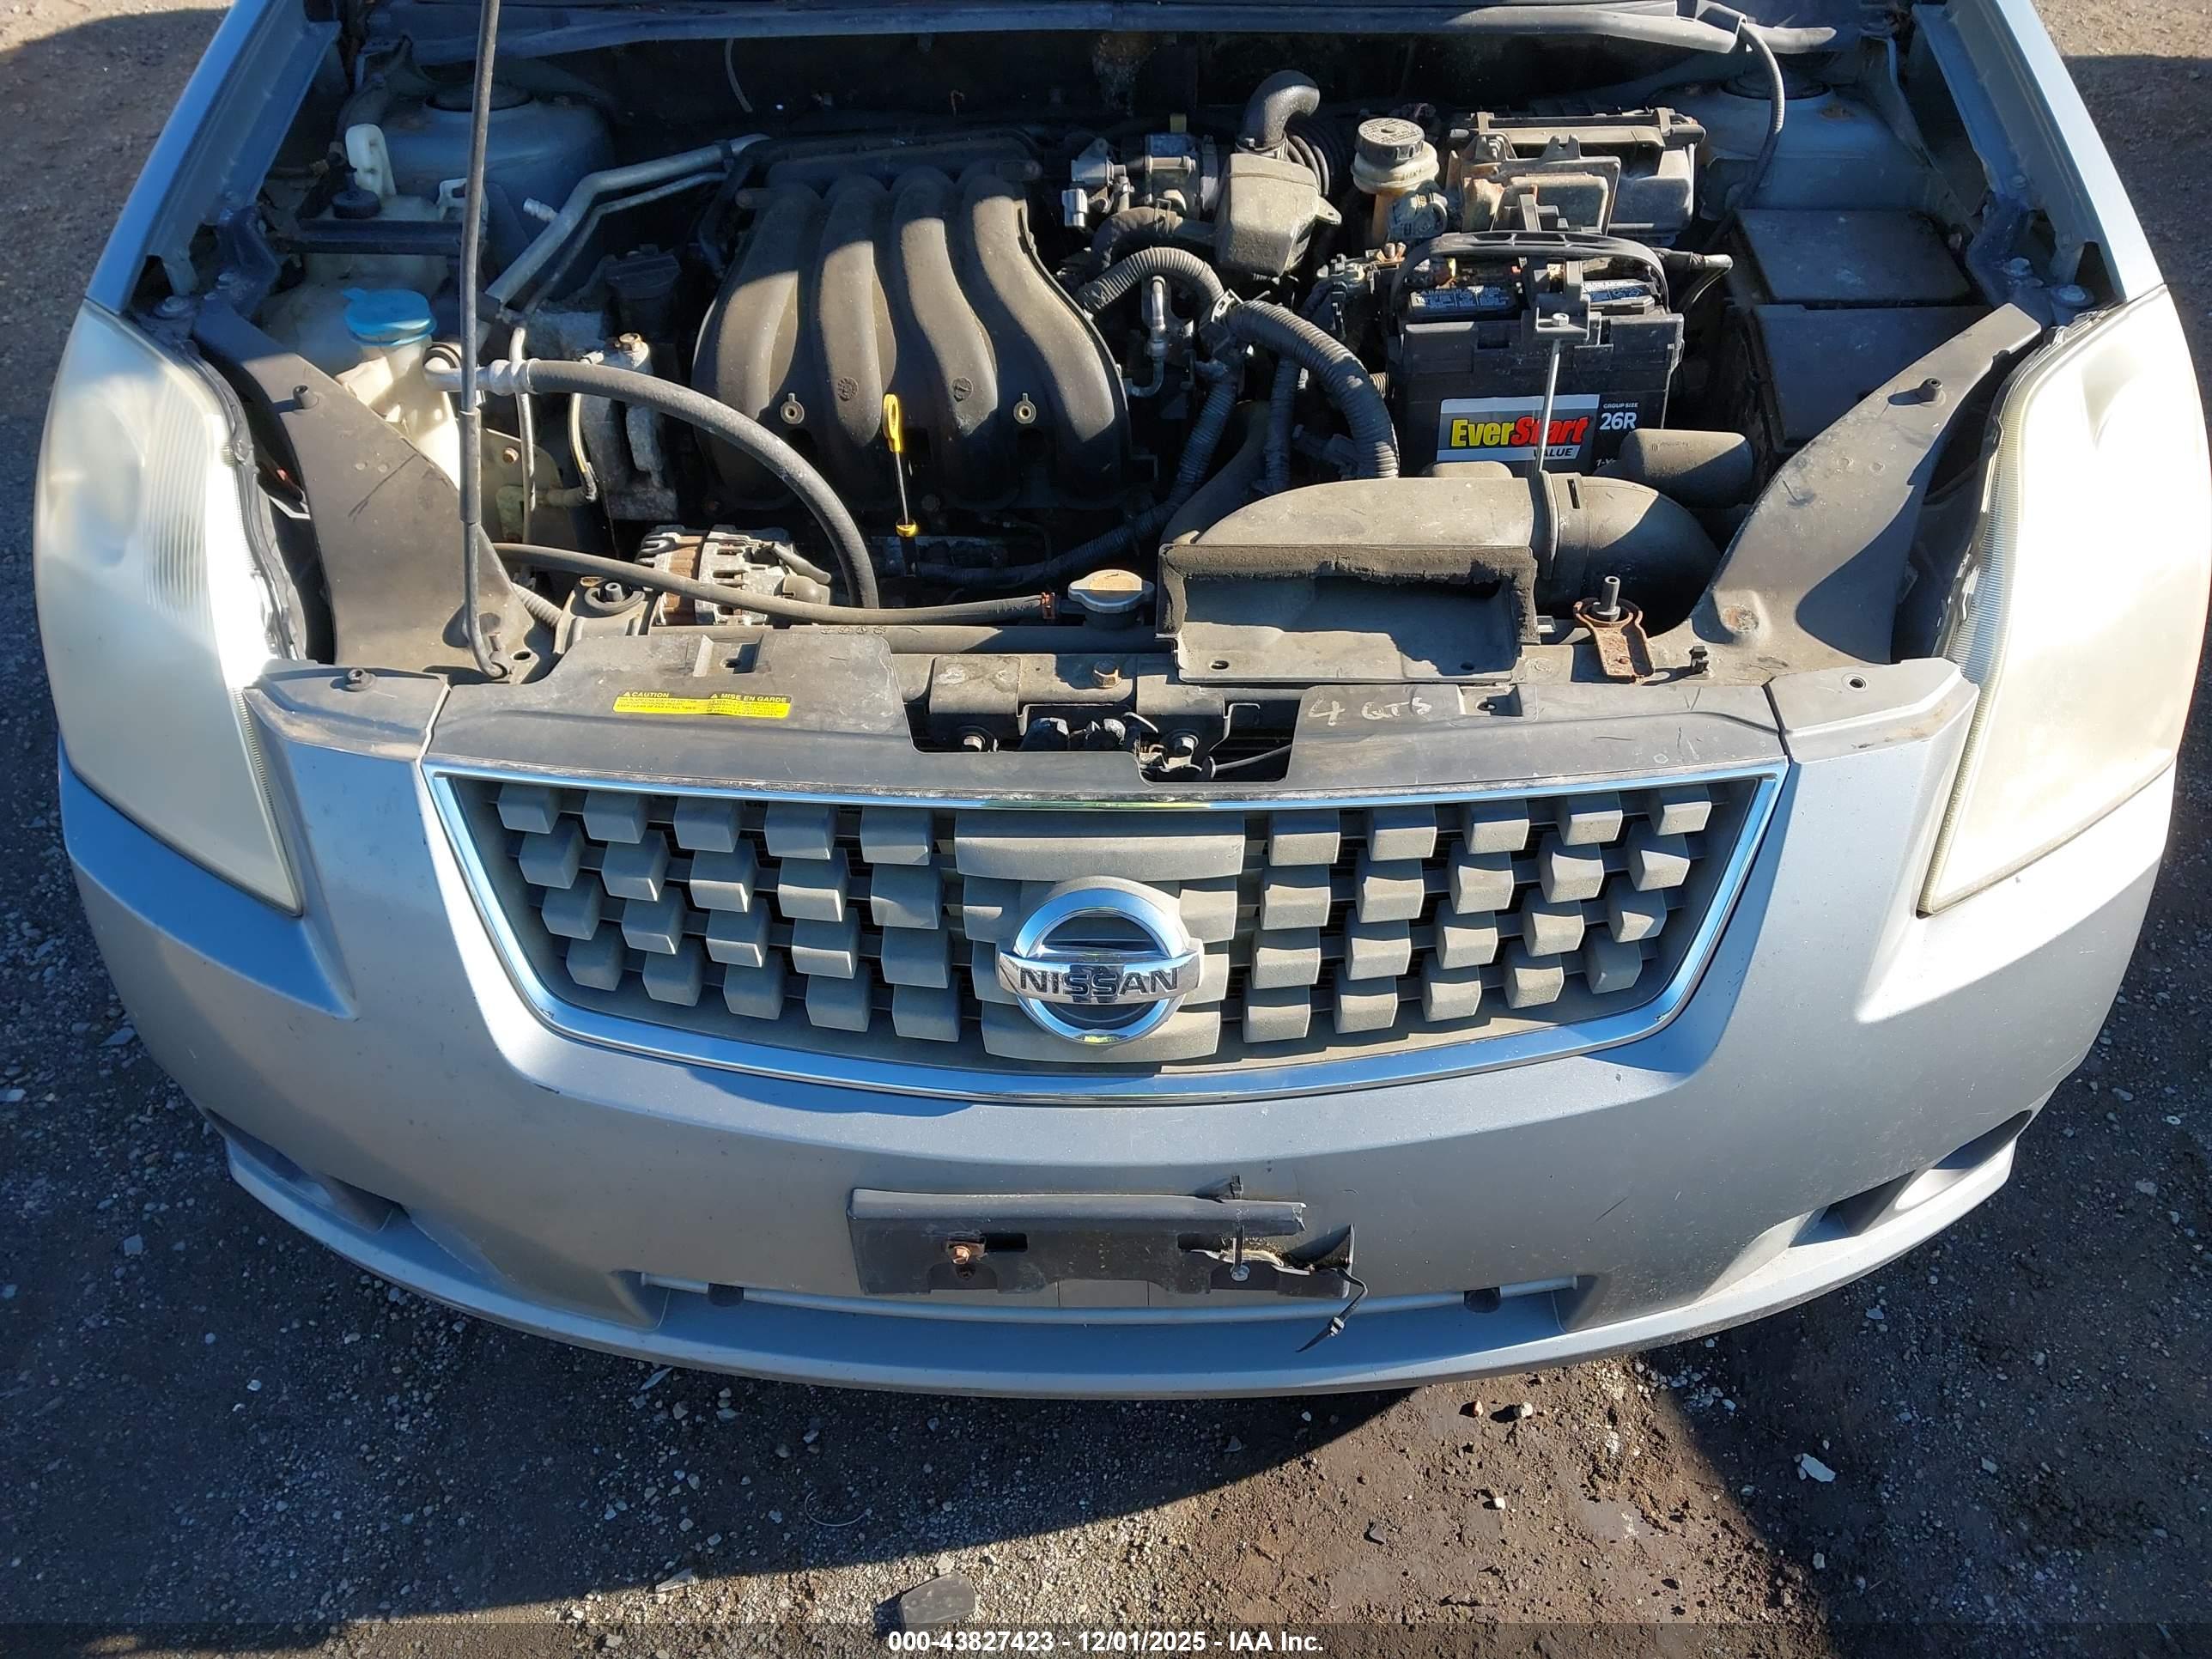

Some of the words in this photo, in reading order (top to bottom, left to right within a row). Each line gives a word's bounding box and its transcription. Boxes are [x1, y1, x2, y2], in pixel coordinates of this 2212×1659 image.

[1449, 415, 1589, 448] EverStart
[1600, 411, 1638, 430] 26R
[1308, 696, 1346, 727] 4
[1019, 966, 1178, 997] NISSAN
